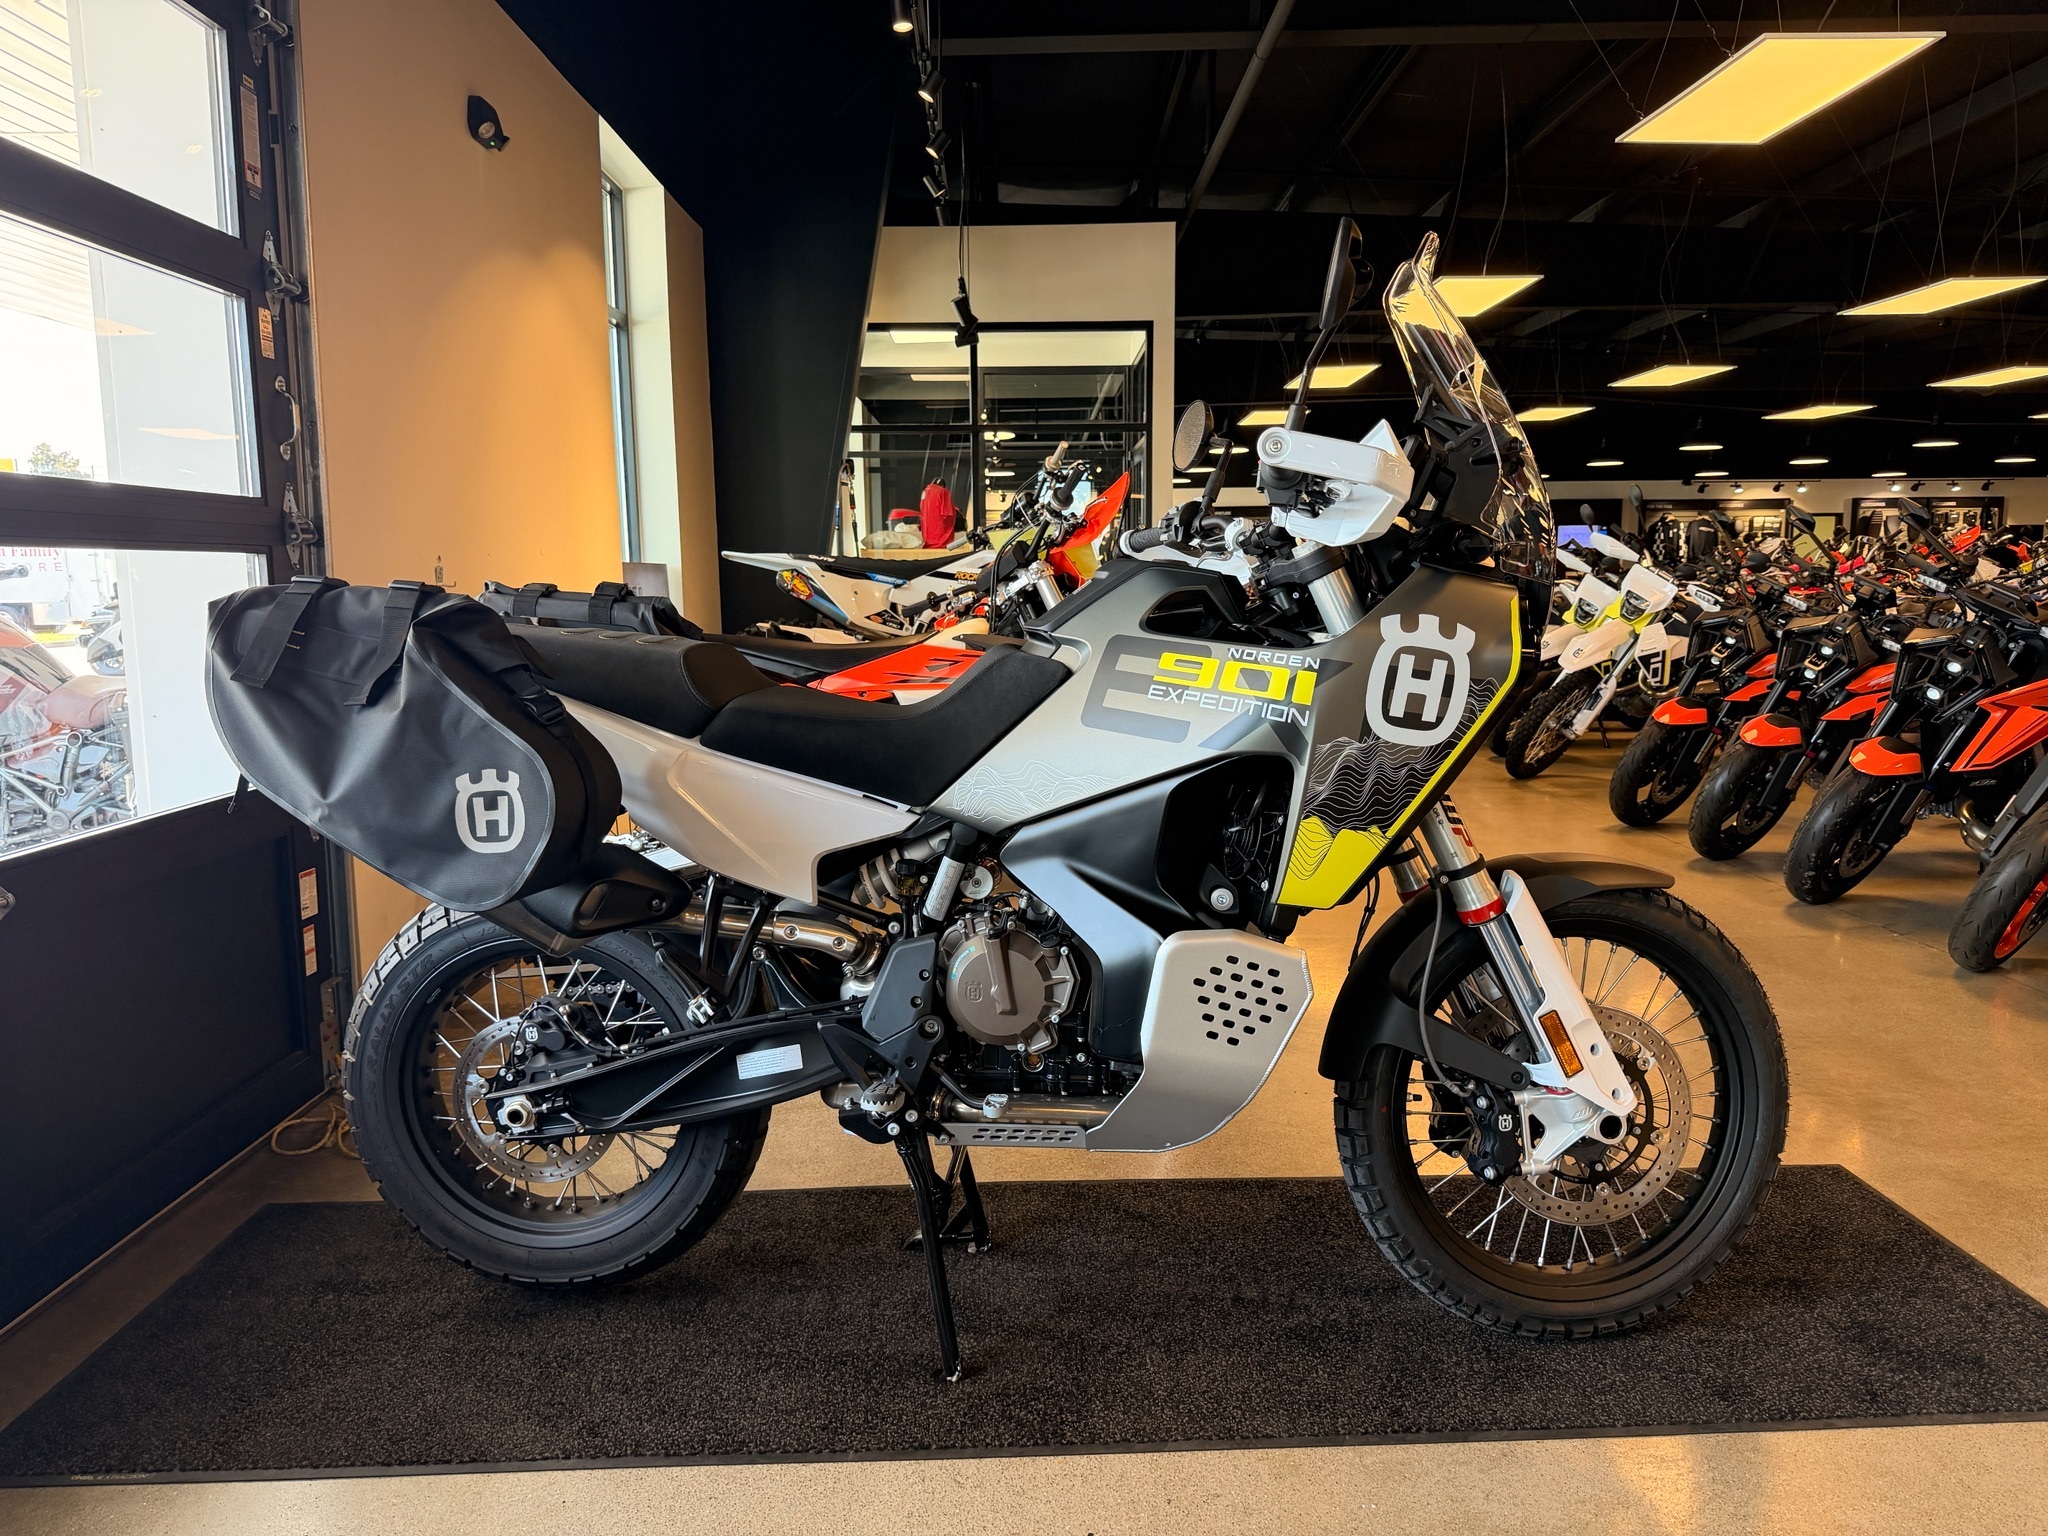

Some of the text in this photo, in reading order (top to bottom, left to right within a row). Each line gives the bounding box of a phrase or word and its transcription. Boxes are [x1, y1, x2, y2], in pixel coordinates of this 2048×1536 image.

[12, 547, 59, 561] Family
[1152, 651, 1318, 706] 901
[1228, 647, 1320, 670] NORDEN
[1147, 684, 1310, 727] EXPEDITION
[364, 992, 401, 1075] RALLY
[400, 951, 436, 997] STR
